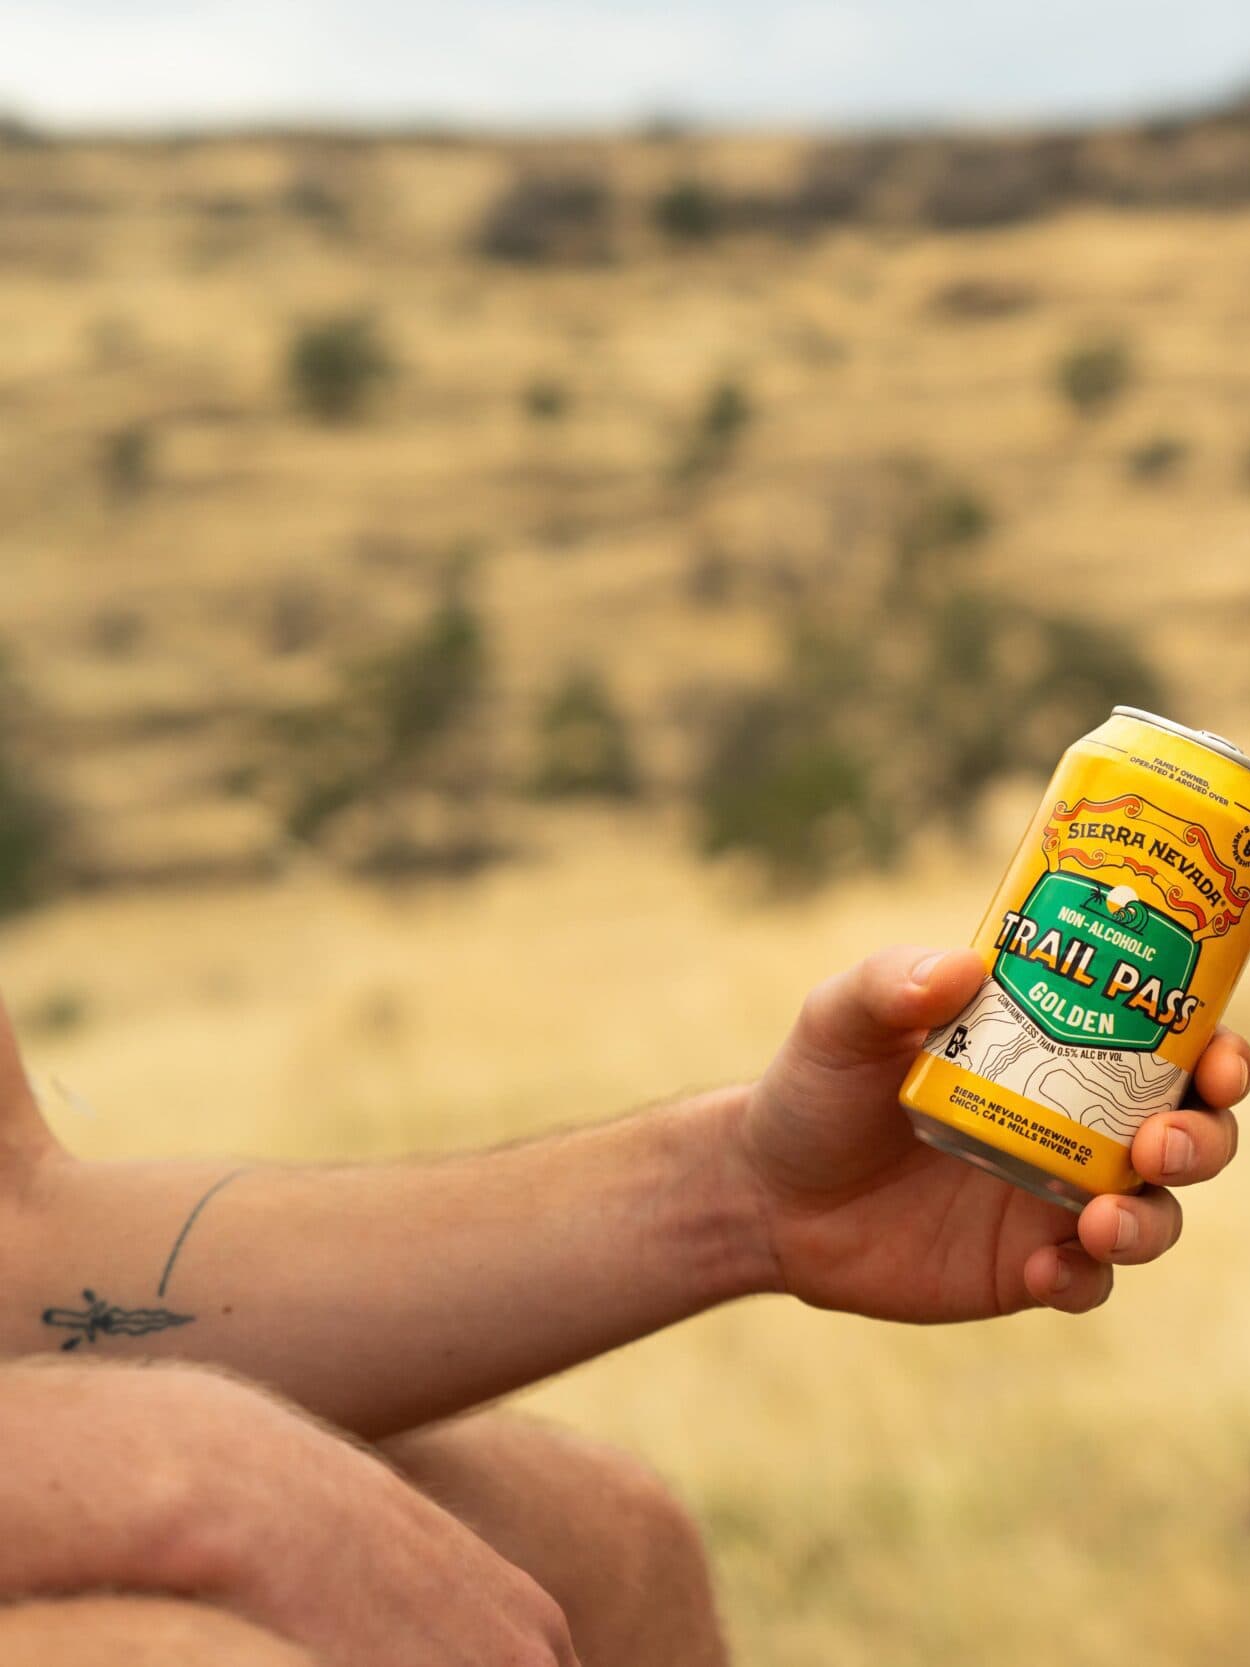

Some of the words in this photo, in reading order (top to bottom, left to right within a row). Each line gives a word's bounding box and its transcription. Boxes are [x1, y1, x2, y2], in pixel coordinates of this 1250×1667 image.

[1130, 756, 1168, 776] OPERATED
[1168, 772, 1175, 780] &
[1175, 776, 1208, 795] ARGUED
[1208, 791, 1229, 806] OVER
[1153, 758, 1180, 772] FAMILY
[1180, 769, 1210, 789] OWNED,
[1067, 822, 1146, 849] SIERRA
[994, 910, 1098, 988] TRAIL
[1058, 906, 1157, 962] NON-ALCOHOLIC
[997, 994, 1025, 1024] CONTAINS
[1021, 1021, 1039, 1039] LESS
[1036, 1036, 1058, 1054] THAN
[1057, 1047, 1078, 1058] 0.5%
[1080, 1051, 1095, 1060] ALC
[1097, 1051, 1108, 1060] BY
[1109, 1052, 1123, 1062] VOL
[1028, 981, 1115, 1035] GOLDEN
[949, 1094, 980, 1116] CHICO,
[982, 1110, 996, 1122] CA
[997, 1118, 1005, 1126] &
[1007, 1120, 1038, 1141] MILLS
[1039, 1136, 1072, 1160] RIVER,
[1073, 1154, 1089, 1166] NC
[953, 1086, 986, 1106] SIERRA
[988, 1102, 1029, 1127] NEVADA
[1030, 1122, 1078, 1150] BREWING
[1078, 1145, 1093, 1159] CO.
